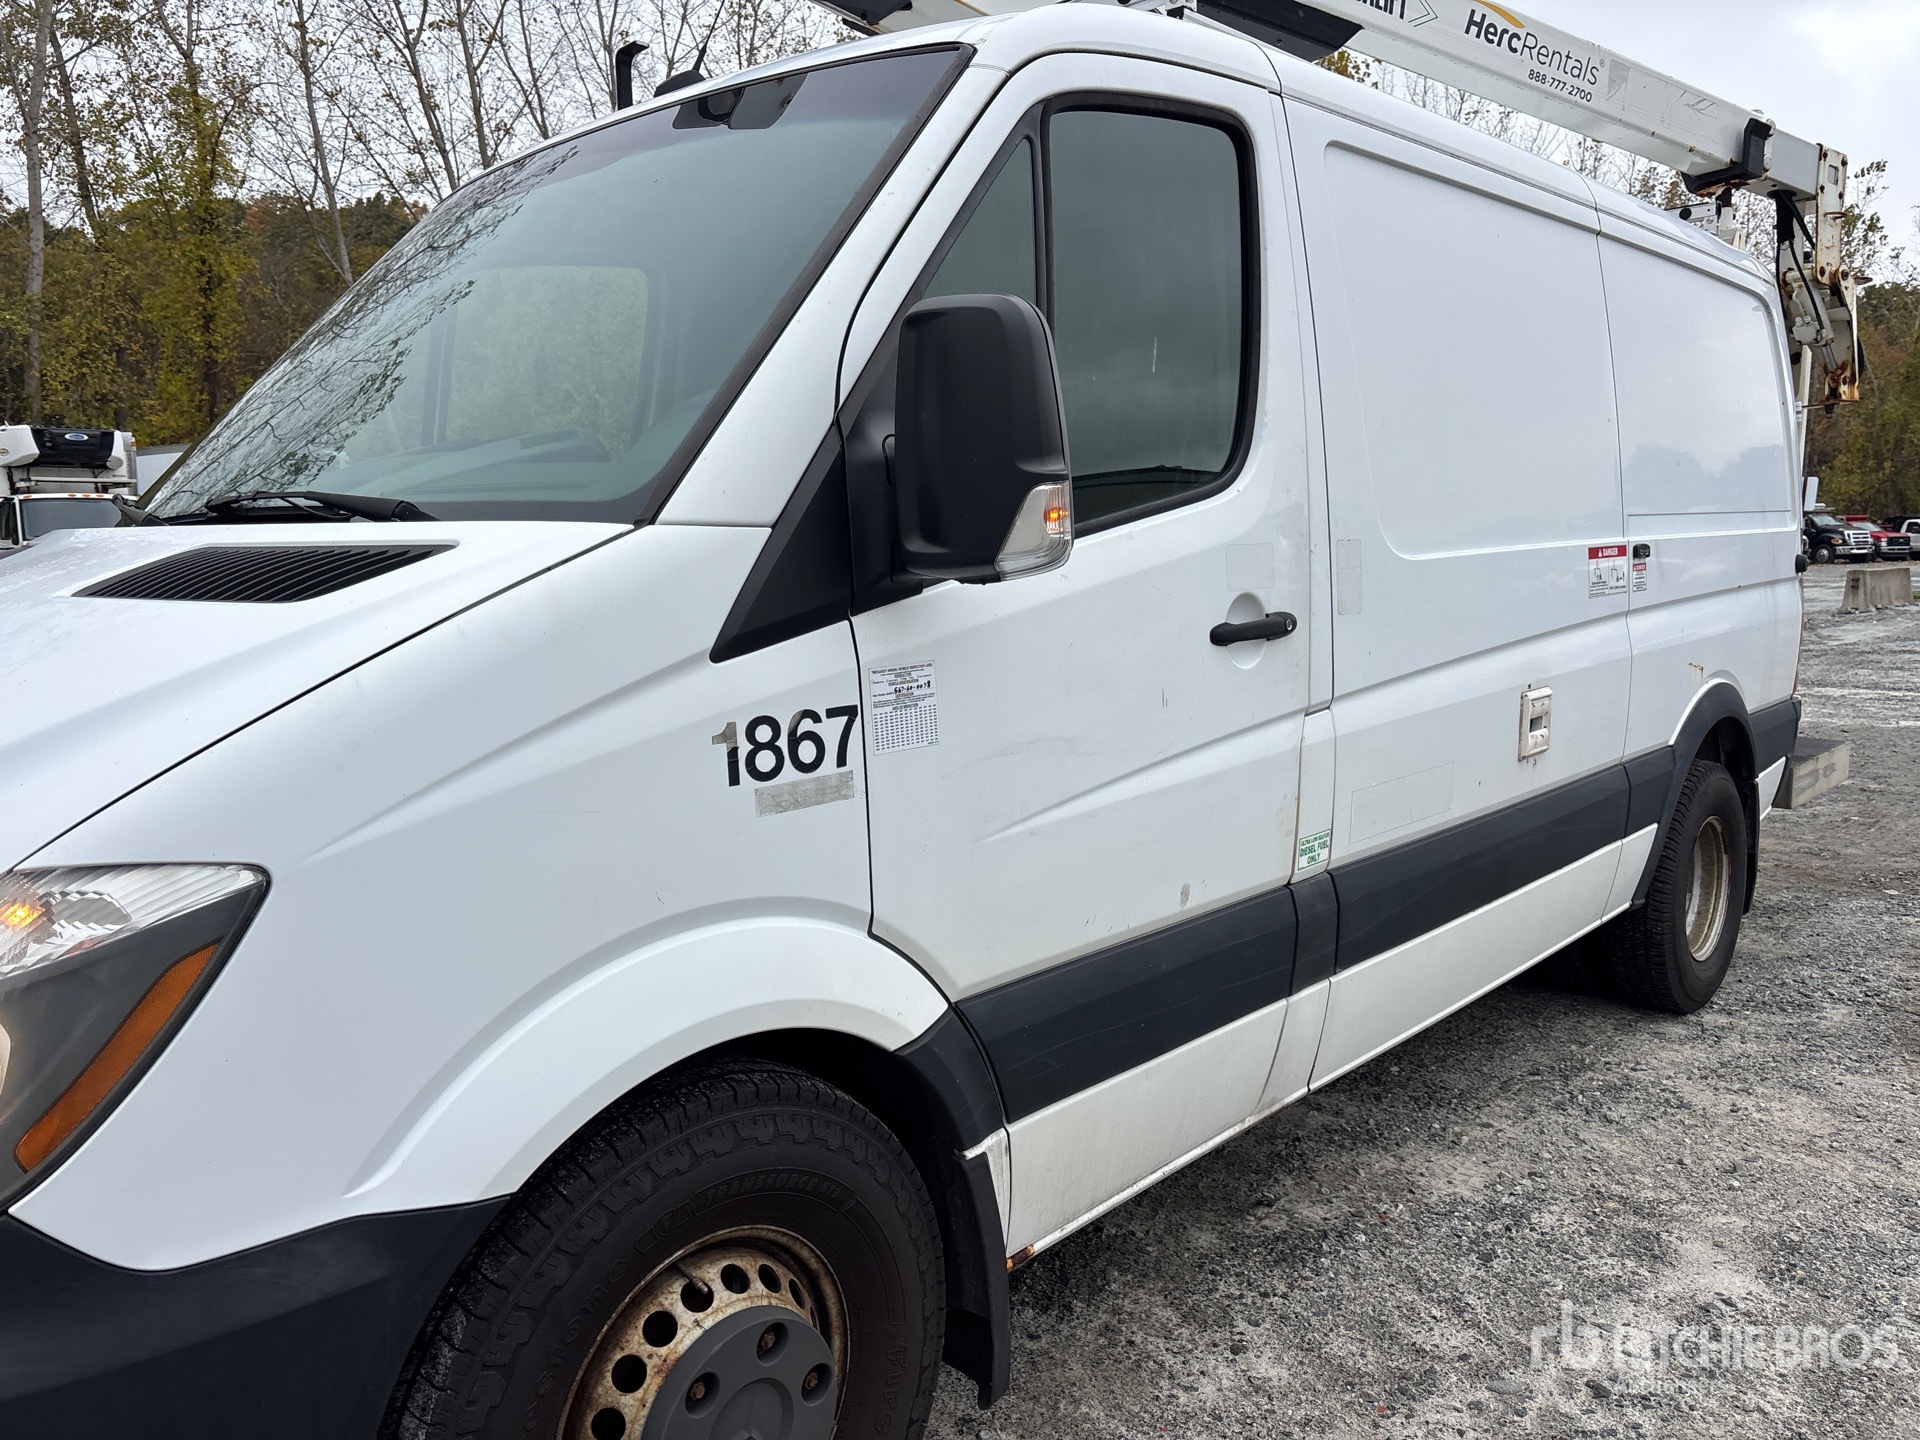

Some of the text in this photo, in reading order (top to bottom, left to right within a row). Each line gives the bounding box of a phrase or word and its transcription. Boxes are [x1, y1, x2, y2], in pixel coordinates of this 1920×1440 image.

[1528, 68, 1593, 103] 888-777-2700
[1602, 547, 1618, 556] DANGER
[711, 704, 859, 787] 1867
[1300, 839, 1329, 857] DIESEL FUEL
[1307, 852, 1321, 865] ONLY
[705, 1173, 820, 1207] TRANSFORCE
